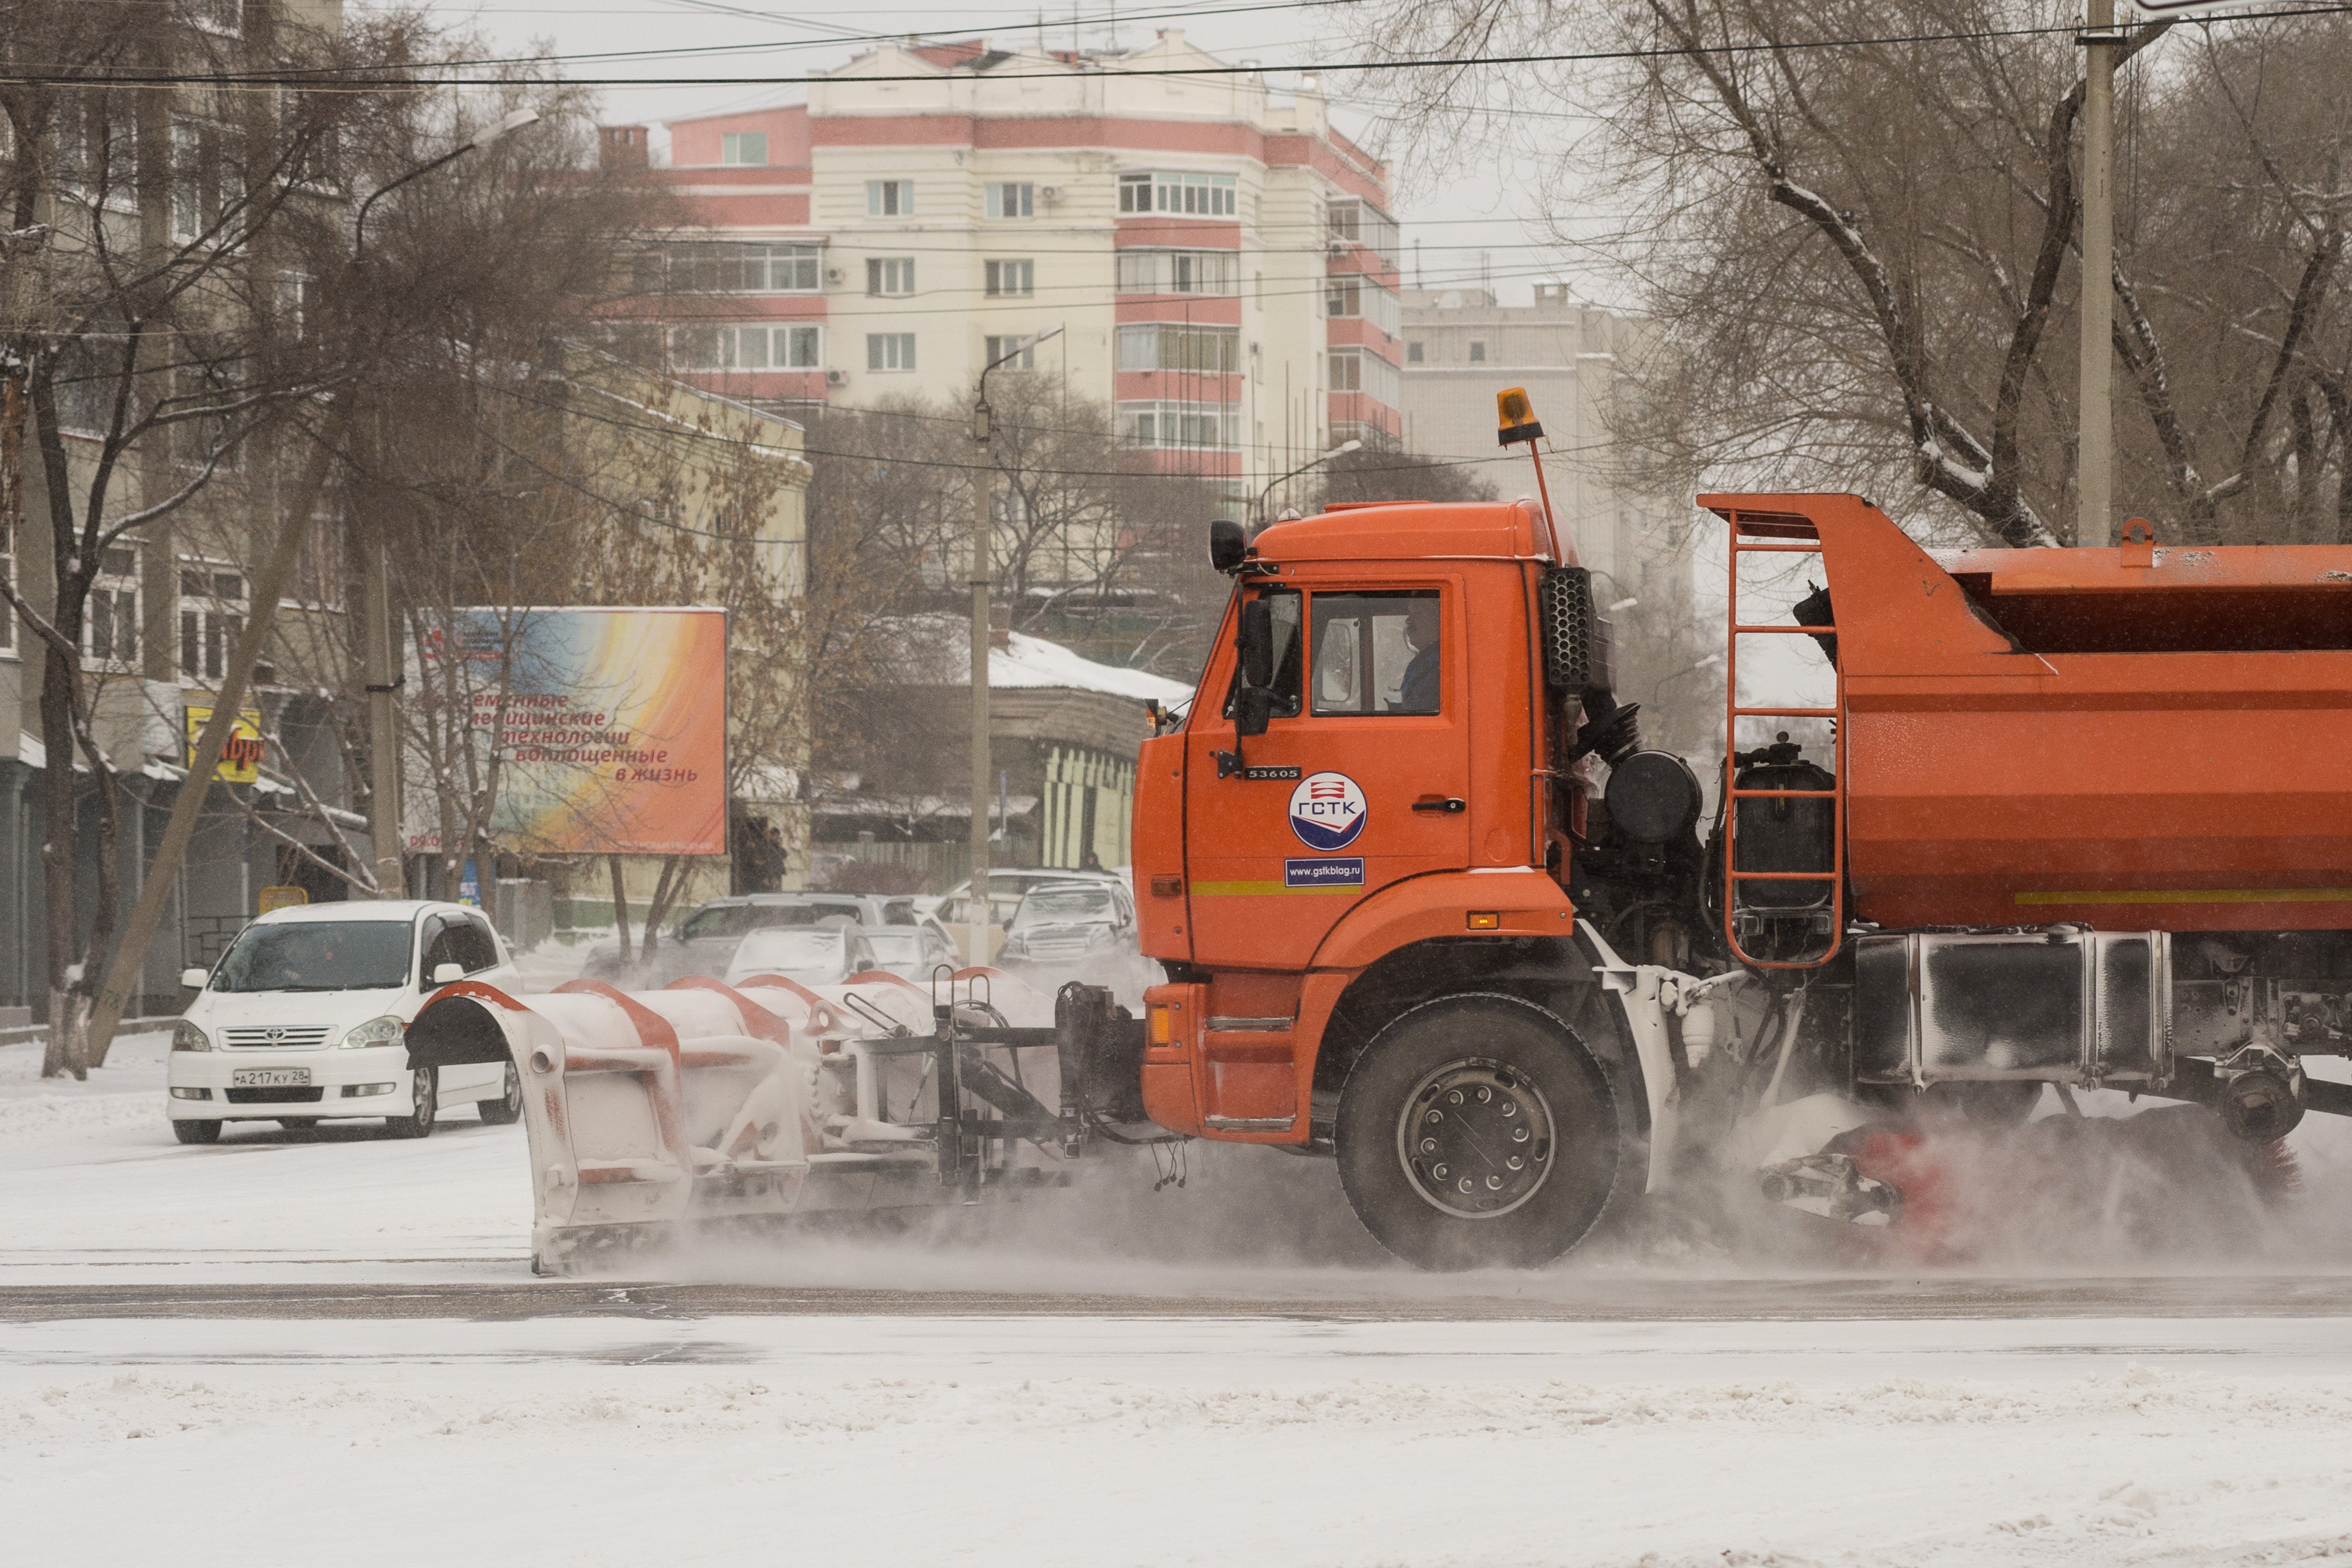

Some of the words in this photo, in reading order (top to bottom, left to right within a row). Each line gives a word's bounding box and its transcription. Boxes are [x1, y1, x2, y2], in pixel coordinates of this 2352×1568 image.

[615, 768, 626, 781] в
[631, 768, 698, 782] жизнь
[1249, 770, 1298, 778] 53605
[1299, 801, 1356, 815] ГСТК
[1290, 866, 1360, 877] www.gstkblag.ru
[293, 1071, 304, 1080] 28
